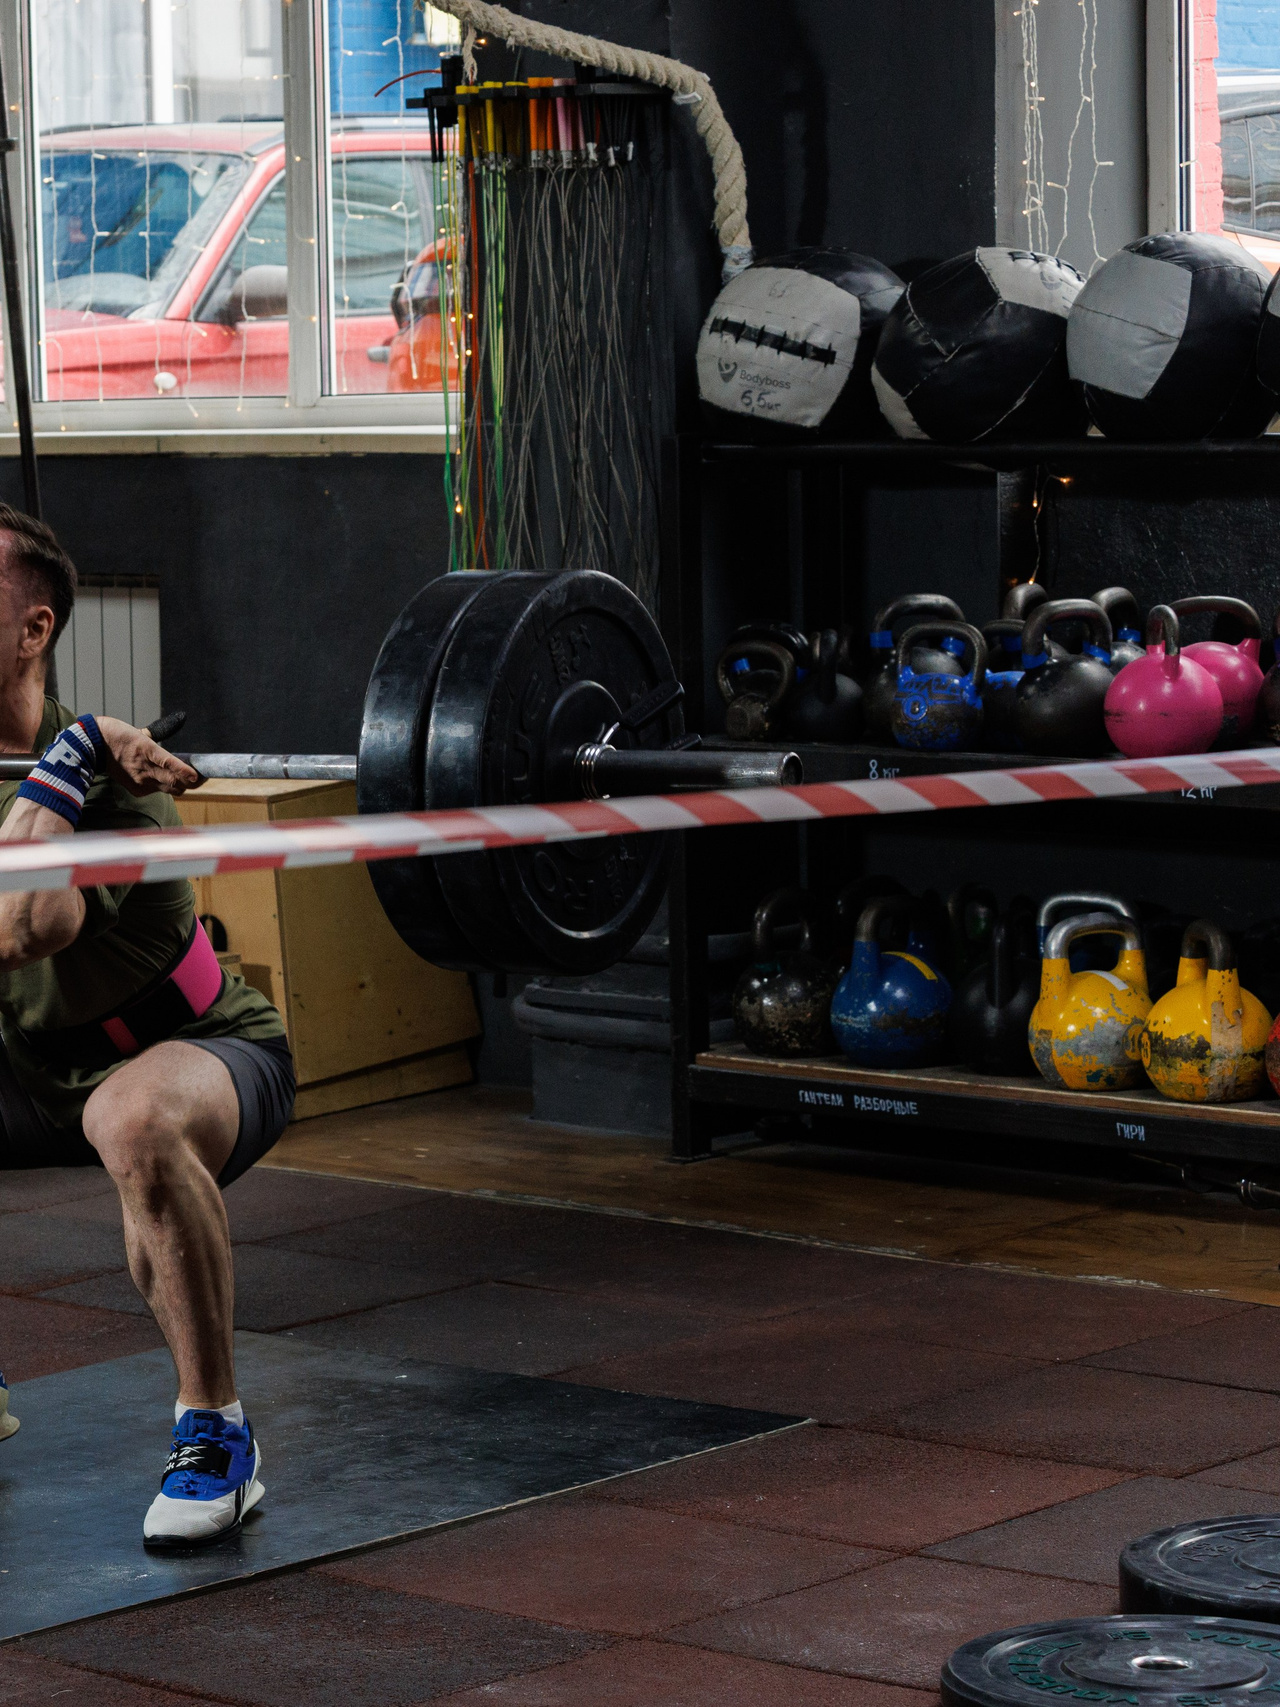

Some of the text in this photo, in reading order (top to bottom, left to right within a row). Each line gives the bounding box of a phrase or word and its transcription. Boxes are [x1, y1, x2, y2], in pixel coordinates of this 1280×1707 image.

[739, 369, 792, 390] Bodyboss
[869, 759, 879, 780] 8
[853, 1094, 919, 1115] РАЗБОРНЫЕ
[1116, 1122, 1146, 1142] ГИРИ
